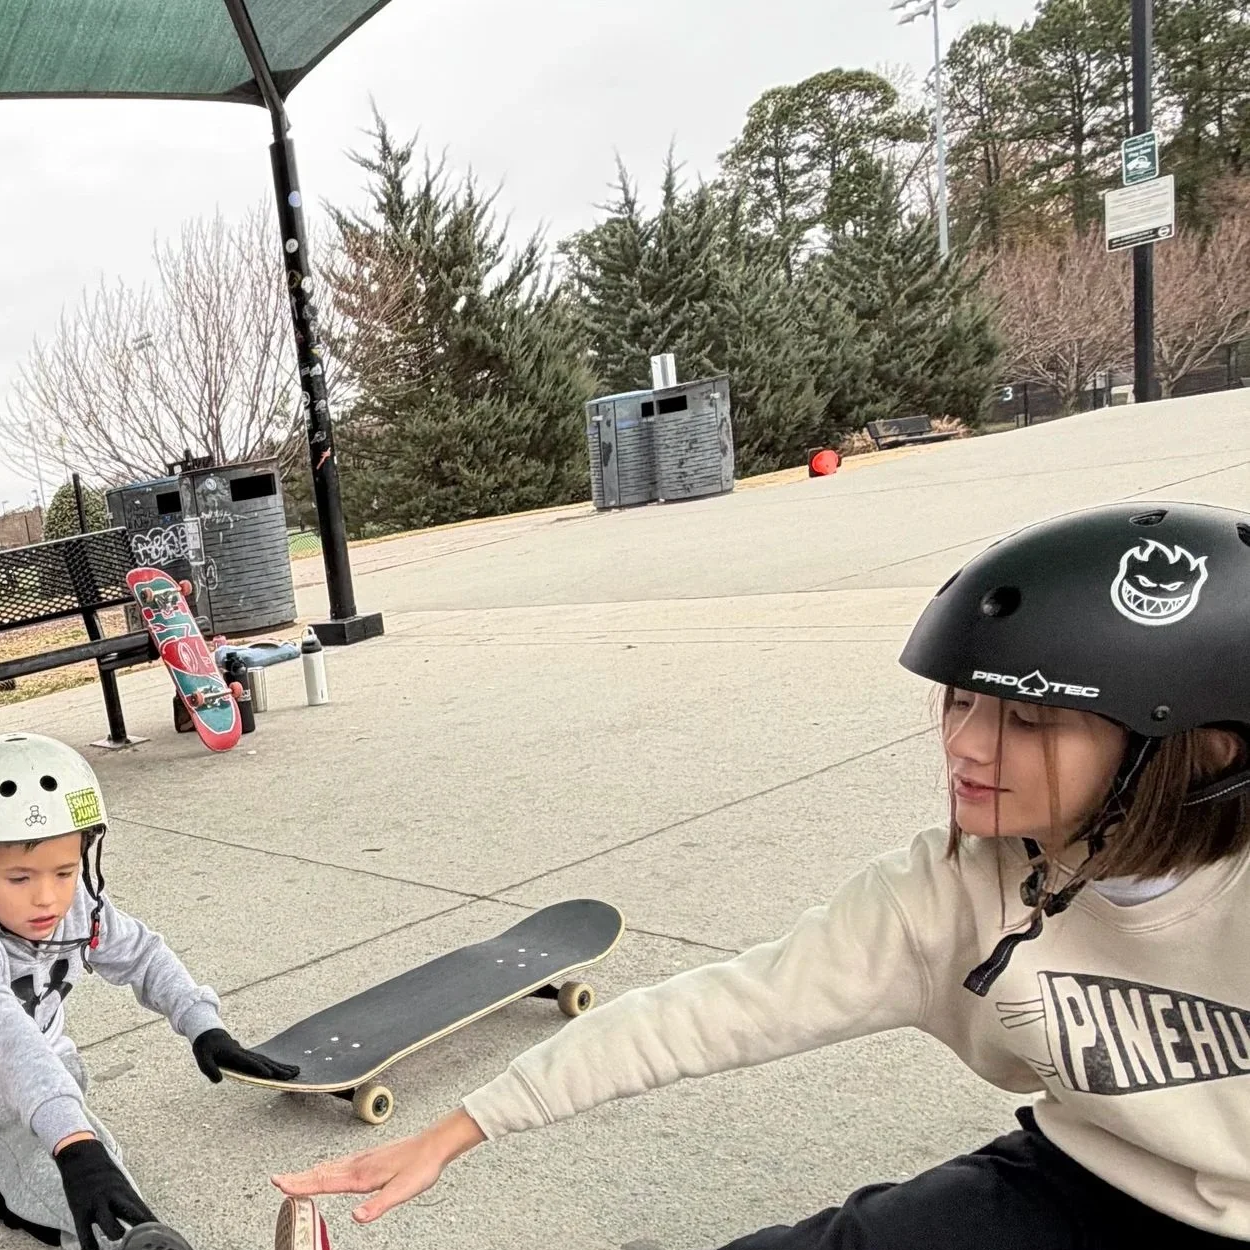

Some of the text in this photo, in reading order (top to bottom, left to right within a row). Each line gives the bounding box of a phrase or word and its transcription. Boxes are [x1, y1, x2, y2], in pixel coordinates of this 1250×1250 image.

[1002, 386, 1013, 401] 3
[972, 670, 1100, 698] PRO TEC
